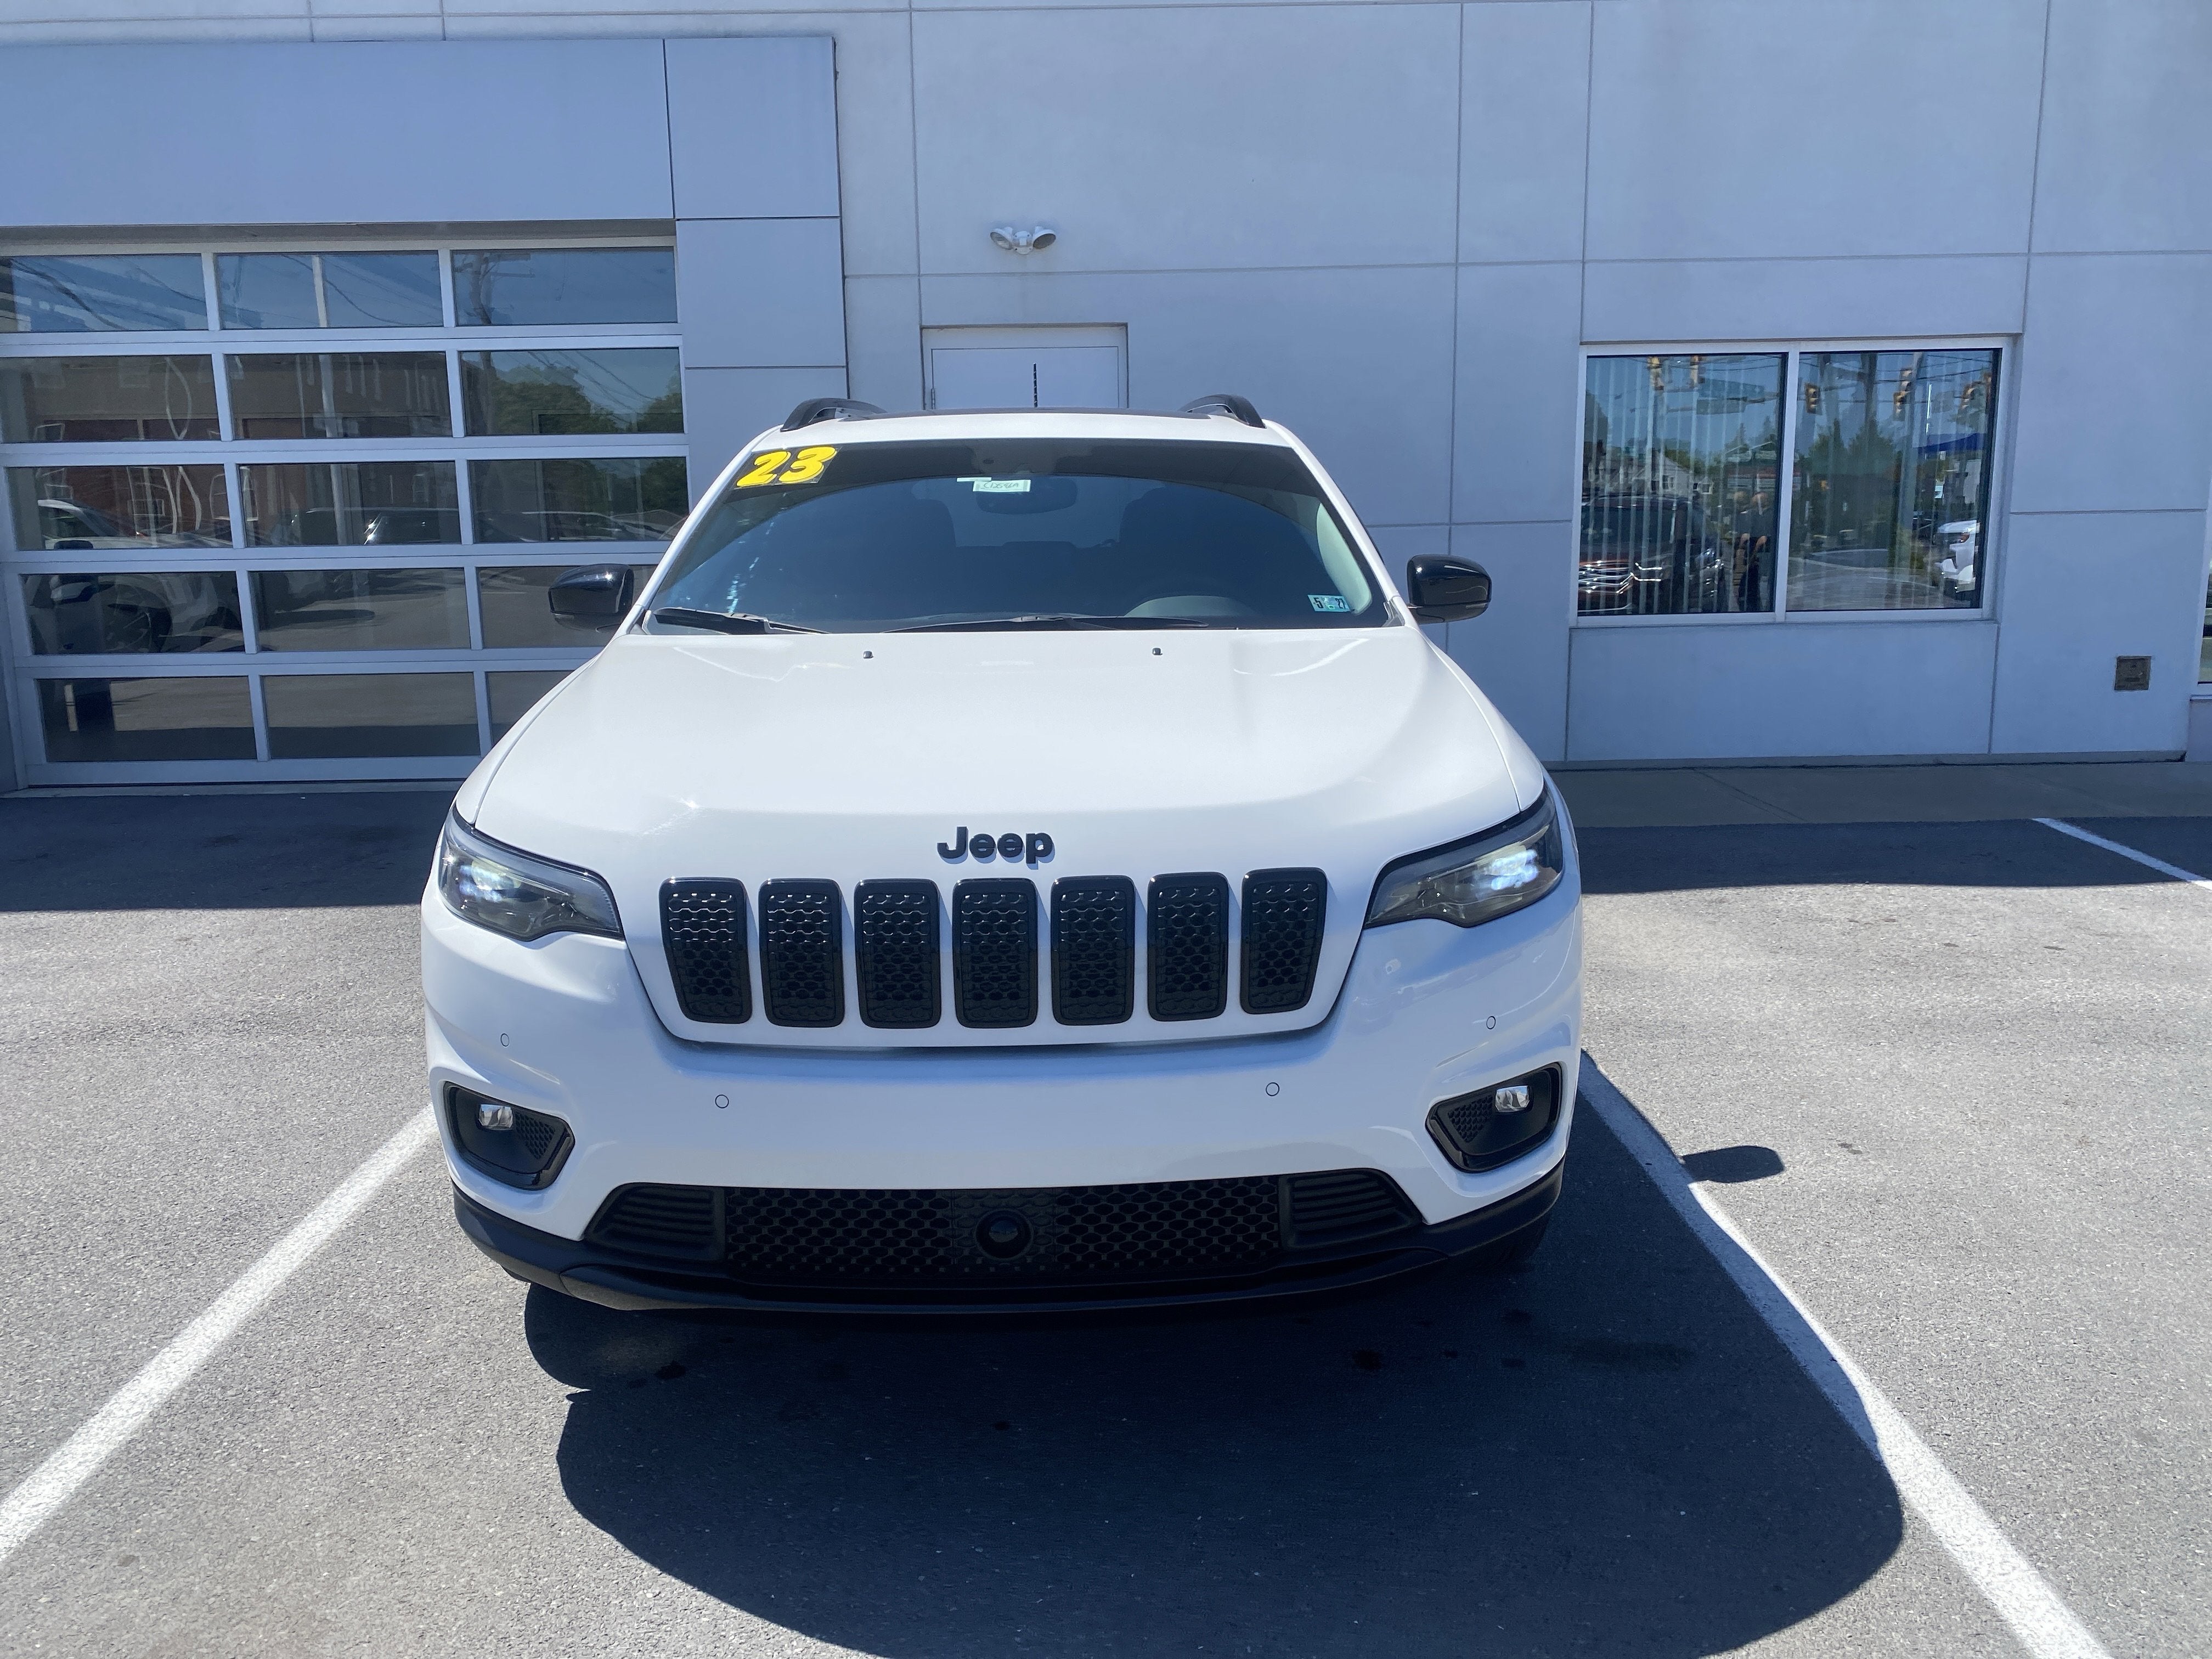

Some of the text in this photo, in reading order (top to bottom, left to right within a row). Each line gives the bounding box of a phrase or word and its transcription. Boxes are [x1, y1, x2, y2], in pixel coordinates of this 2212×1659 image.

[736, 446, 837, 487] 23
[1313, 597, 1346, 610] 5 27
[937, 826, 1054, 865] Jeep
